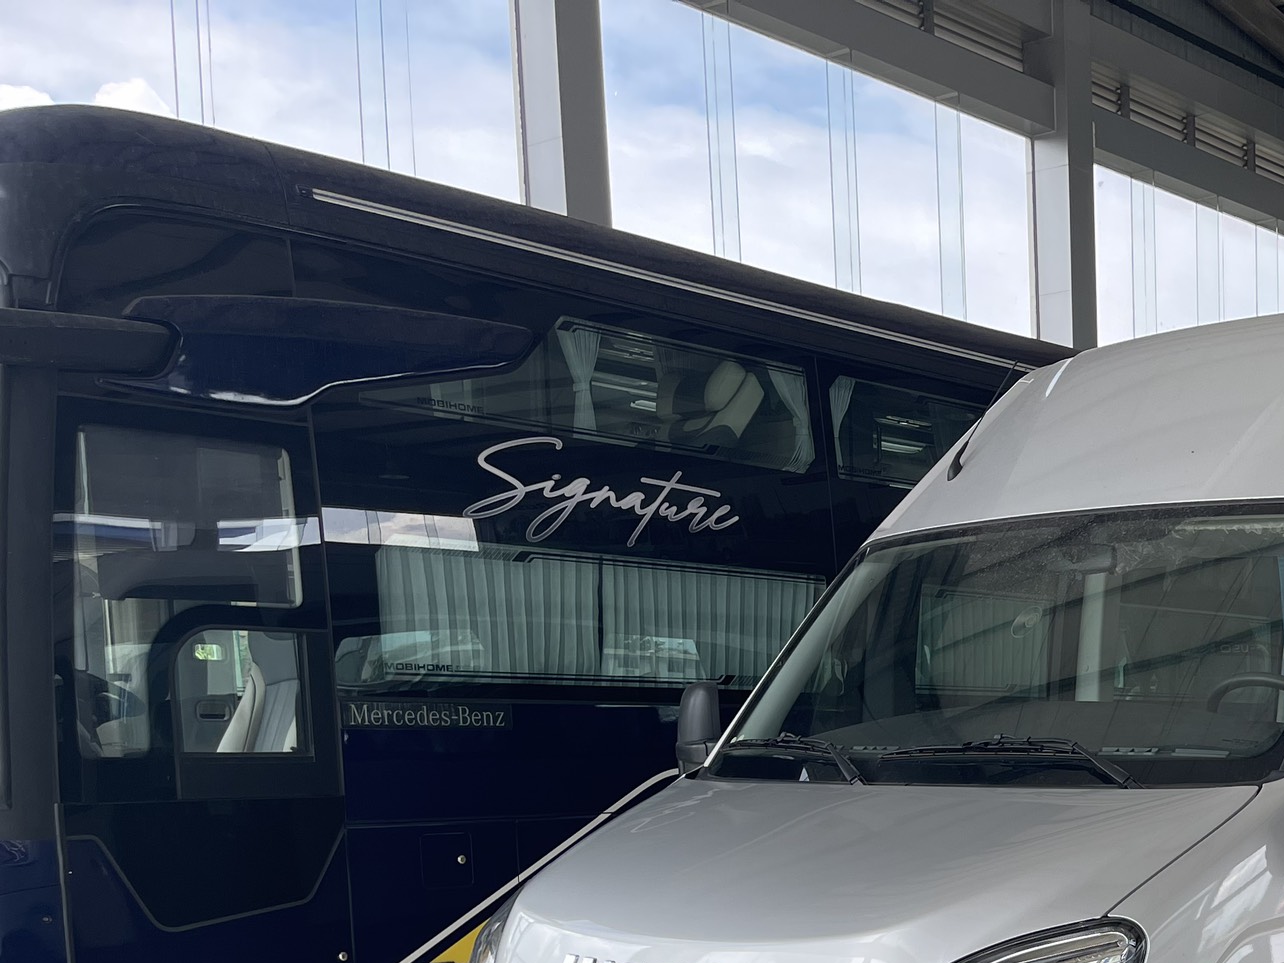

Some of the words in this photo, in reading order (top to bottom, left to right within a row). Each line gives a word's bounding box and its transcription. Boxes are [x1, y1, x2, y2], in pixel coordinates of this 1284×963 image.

[416, 396, 485, 415] MOBIHOME
[462, 436, 740, 548] Signature
[383, 662, 454, 673] MOBIHOME
[349, 703, 506, 728] Mercedes-Benz
